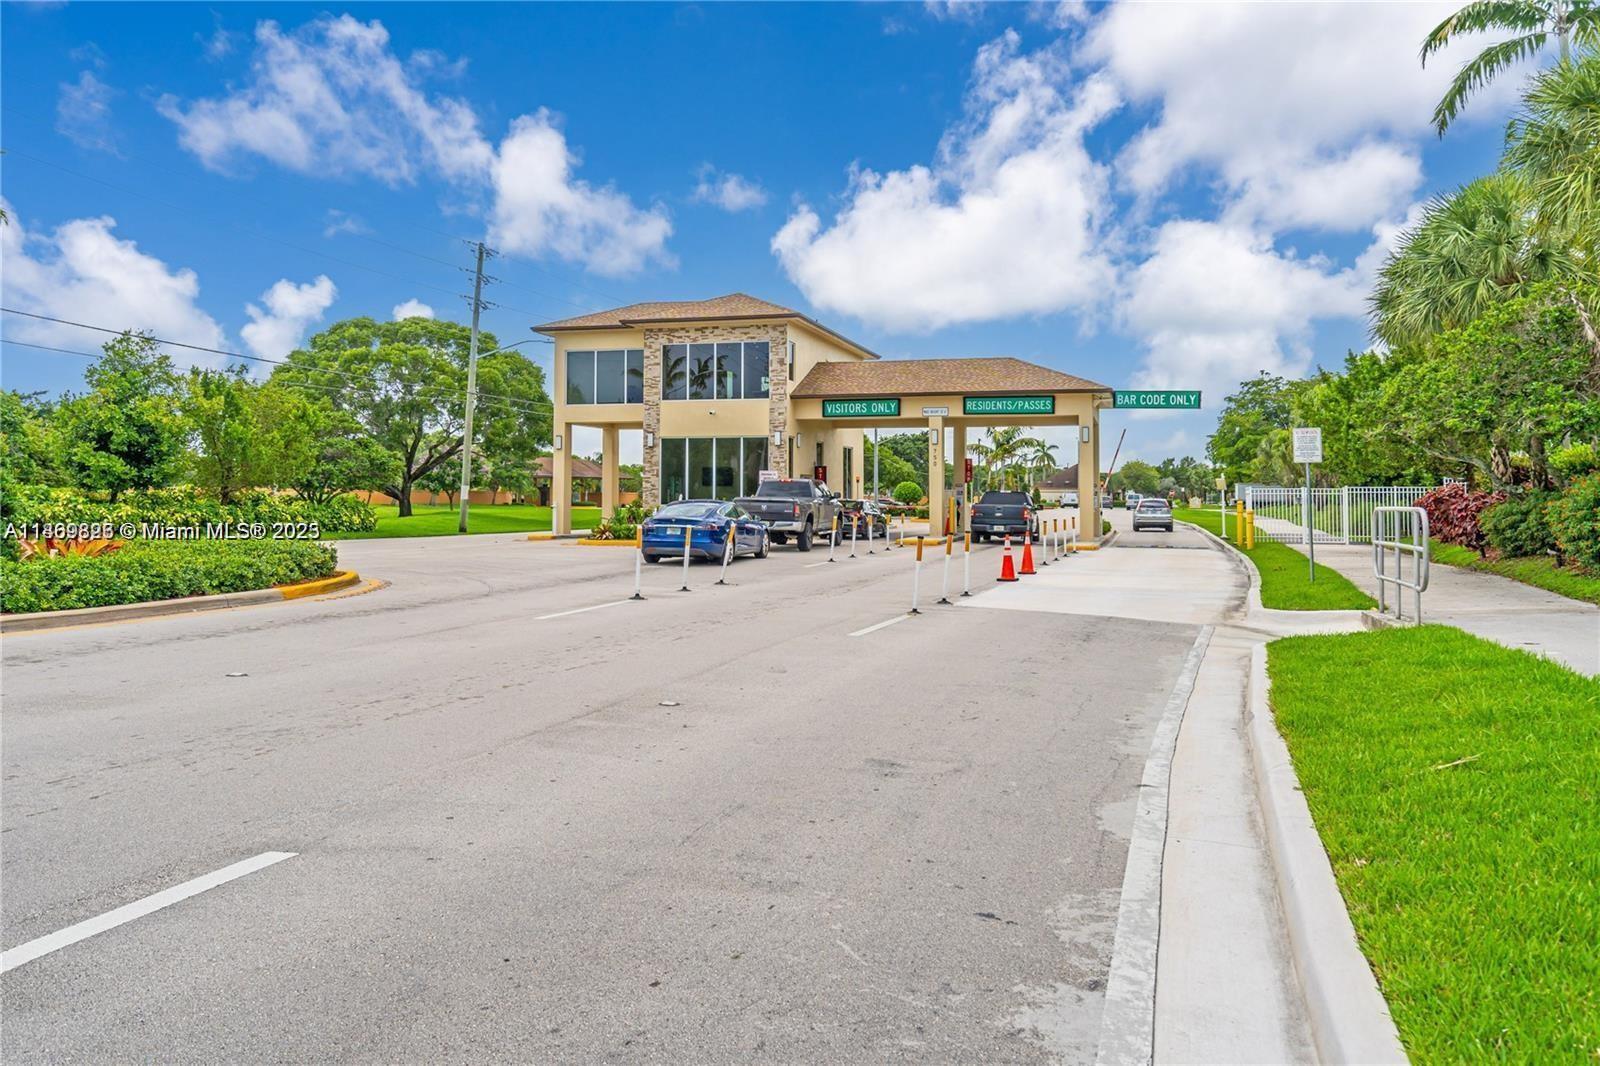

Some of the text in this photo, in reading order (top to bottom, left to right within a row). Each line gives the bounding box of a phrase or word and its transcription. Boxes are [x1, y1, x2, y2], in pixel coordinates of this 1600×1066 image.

[1117, 394, 1196, 405] BAR CODE ONLY
[826, 402, 896, 414] VISITORS ONLY
[966, 400, 1052, 411] RESIDENTS/PASSES
